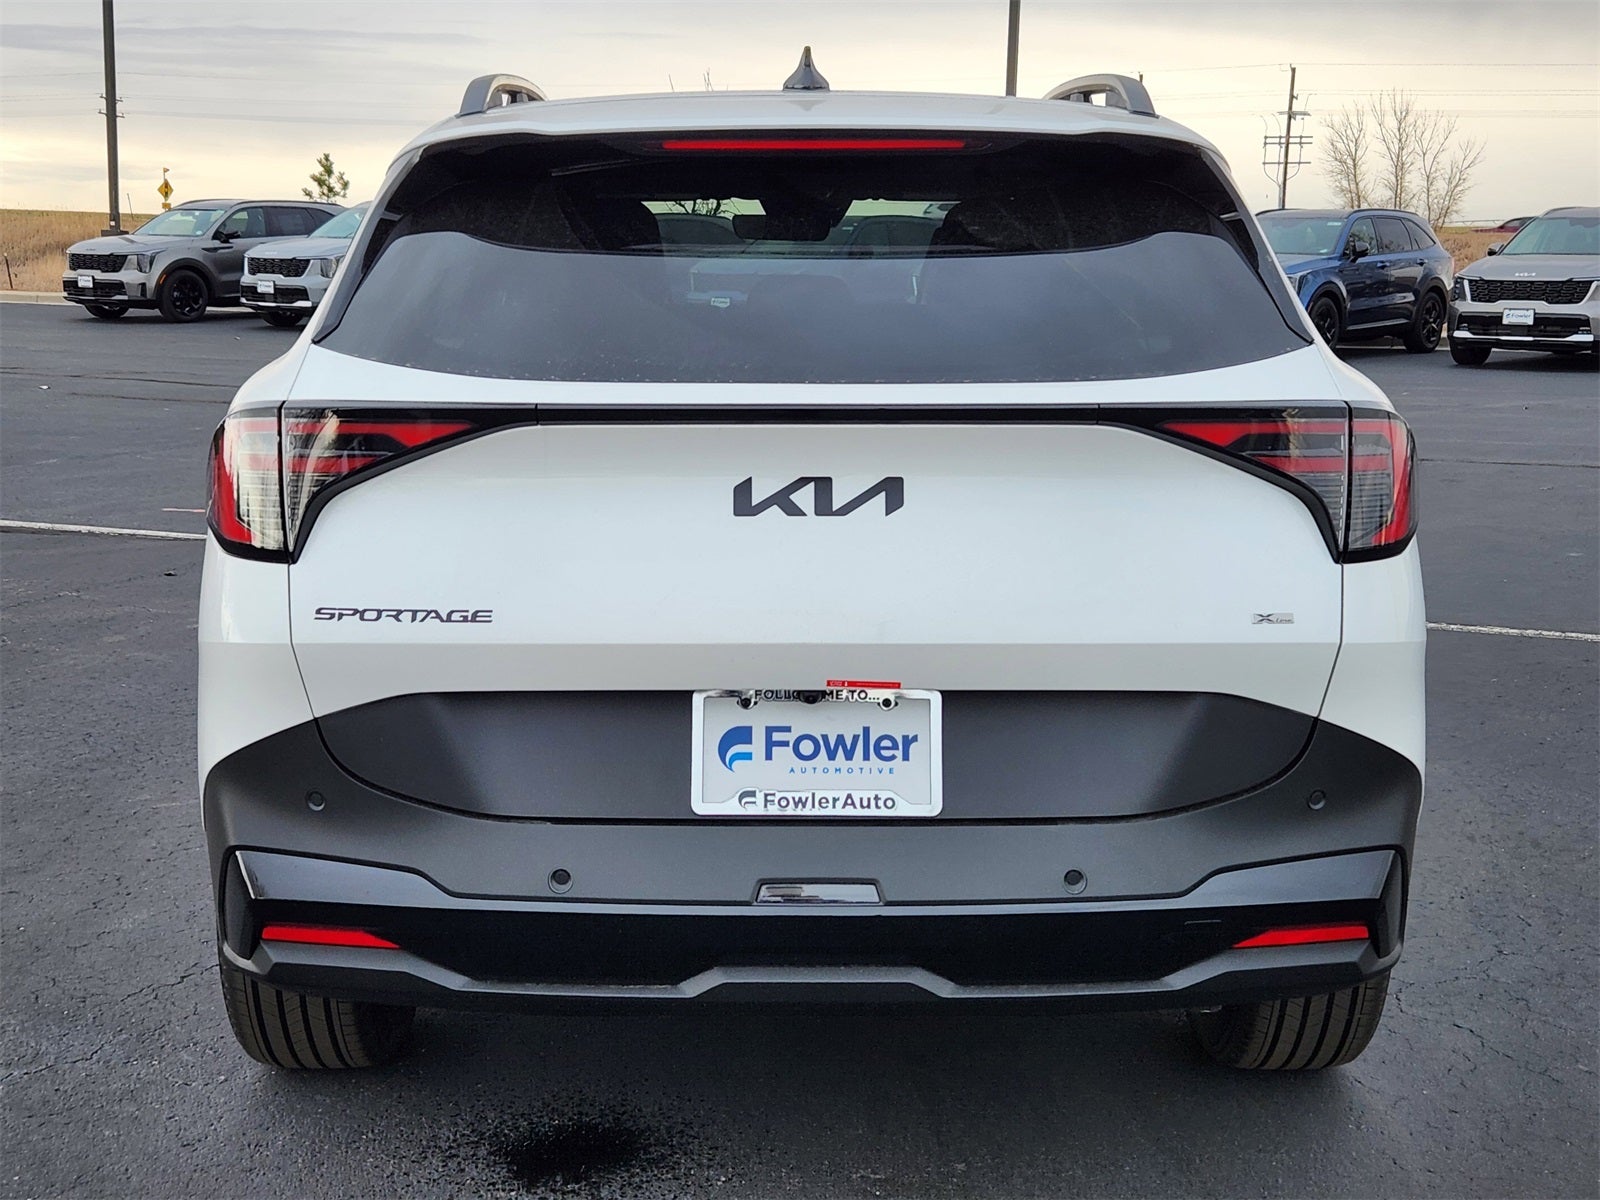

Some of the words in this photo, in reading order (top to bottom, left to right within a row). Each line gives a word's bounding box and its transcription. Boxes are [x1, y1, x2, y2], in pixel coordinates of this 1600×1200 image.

[733, 476, 904, 516] KIA
[314, 607, 493, 623] SPORTAGE
[825, 689, 843, 700] ME
[765, 726, 918, 761] Fowler
[763, 793, 896, 810] FowlerAuto
